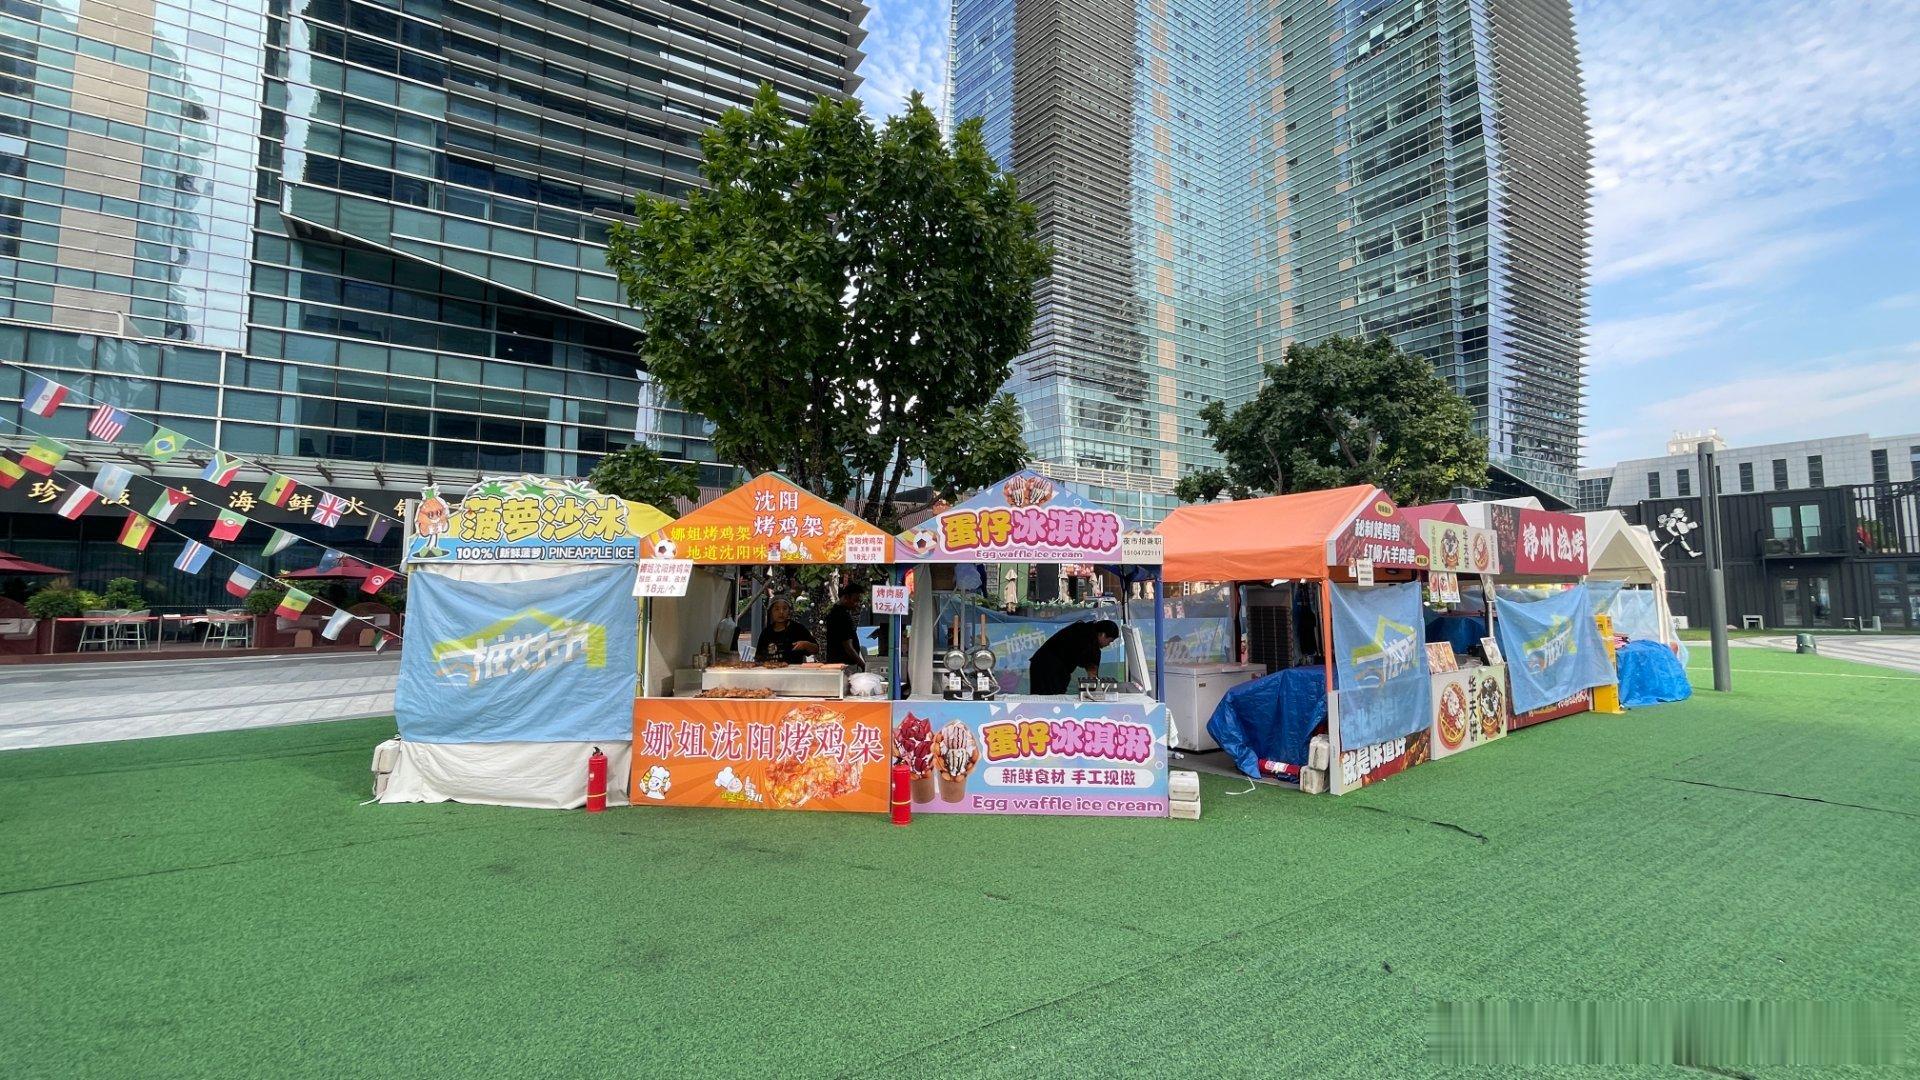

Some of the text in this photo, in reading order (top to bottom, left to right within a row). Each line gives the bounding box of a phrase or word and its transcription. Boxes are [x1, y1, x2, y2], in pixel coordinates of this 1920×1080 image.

[754, 489, 799, 512] 沈阳
[461, 497, 627, 542] 菠萝沙冰
[752, 515, 824, 538] 烤鸡架
[670, 525, 752, 542] 娜姐烤鸡架
[941, 508, 1119, 552] 蛋仔冰淇淋
[848, 537, 884, 545] 沈阳烤鸡架
[457, 547, 493, 560] 100%
[549, 547, 612, 559] PINEAPPLE
[615, 547, 635, 559] ICE
[686, 545, 768, 561] 地道沈阳味
[976, 550, 1083, 559] Egg waffle ice cream
[646, 584, 676, 594] 18元/个
[876, 588, 904, 599] 烤肉肠
[874, 602, 905, 613] 12元/个
[640, 719, 885, 765] 娜姐沈阳烤鸡架
[982, 719, 1152, 763] 蛋仔冰淇淋
[1002, 769, 1136, 786] 新鲜食材 手工现做
[973, 795, 1164, 812] Egg waffle ice cream
